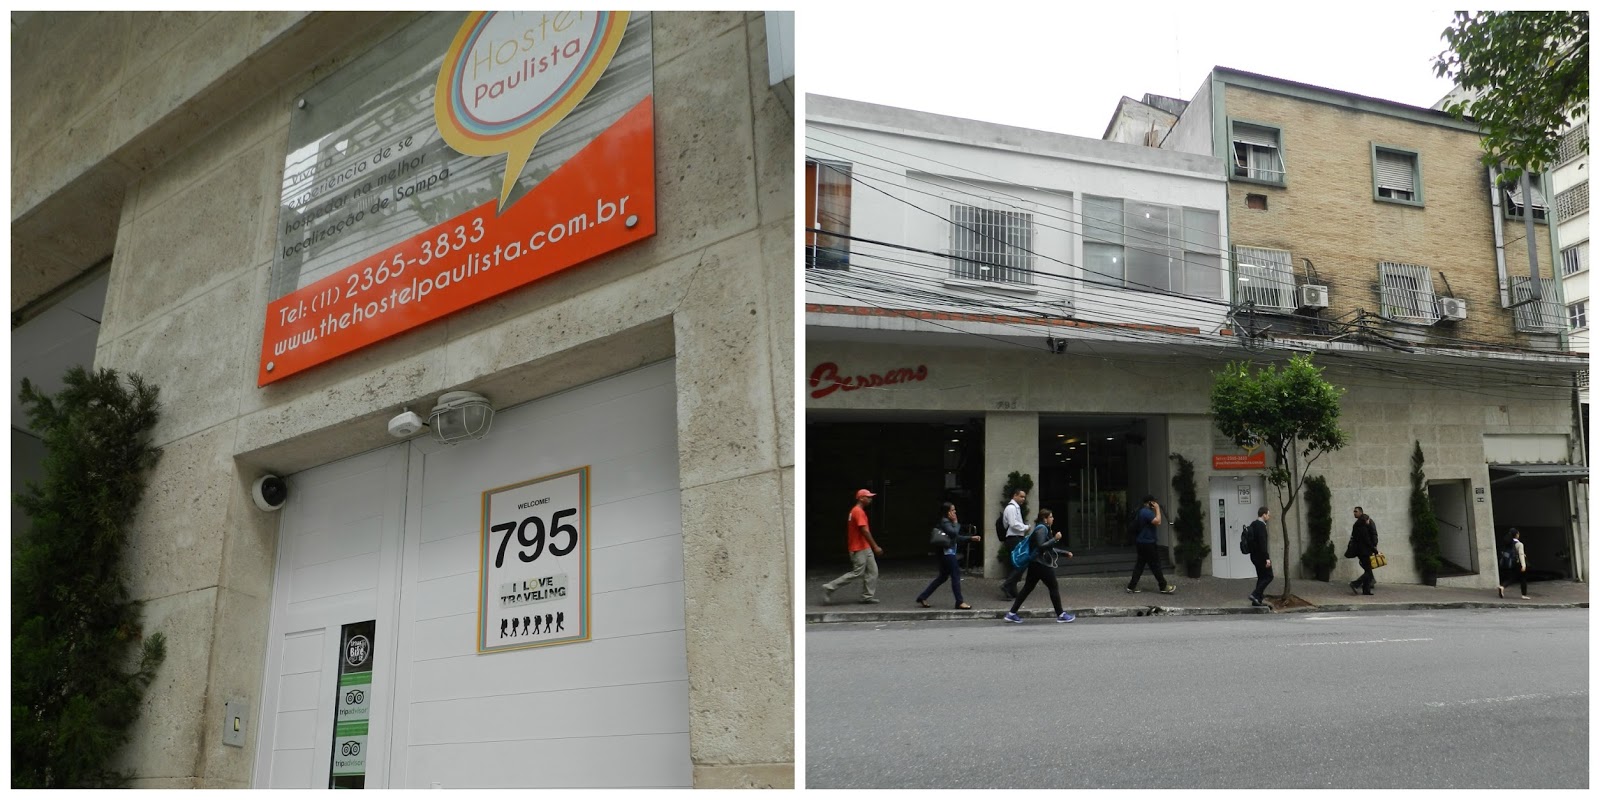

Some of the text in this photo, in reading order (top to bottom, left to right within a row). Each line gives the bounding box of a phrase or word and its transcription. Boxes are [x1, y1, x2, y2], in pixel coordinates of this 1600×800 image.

[474, 38, 580, 108] Paulista
[372, 148, 391, 164] de
[398, 135, 413, 151] se
[282, 168, 453, 259] localização de Sampa.
[285, 152, 426, 235] hospedar na melhor
[274, 195, 630, 356] www.thehostelpaulista.com.br
[279, 217, 485, 327] Tel: (11) 2365-3833
[517, 497, 551, 510] WELCOME!
[491, 508, 578, 568] 795
[501, 587, 566, 605] TRAVELING
[512, 576, 554, 593] I LOVE
[340, 708, 367, 716] tripadvisor
[335, 760, 363, 768] tripadvisor
